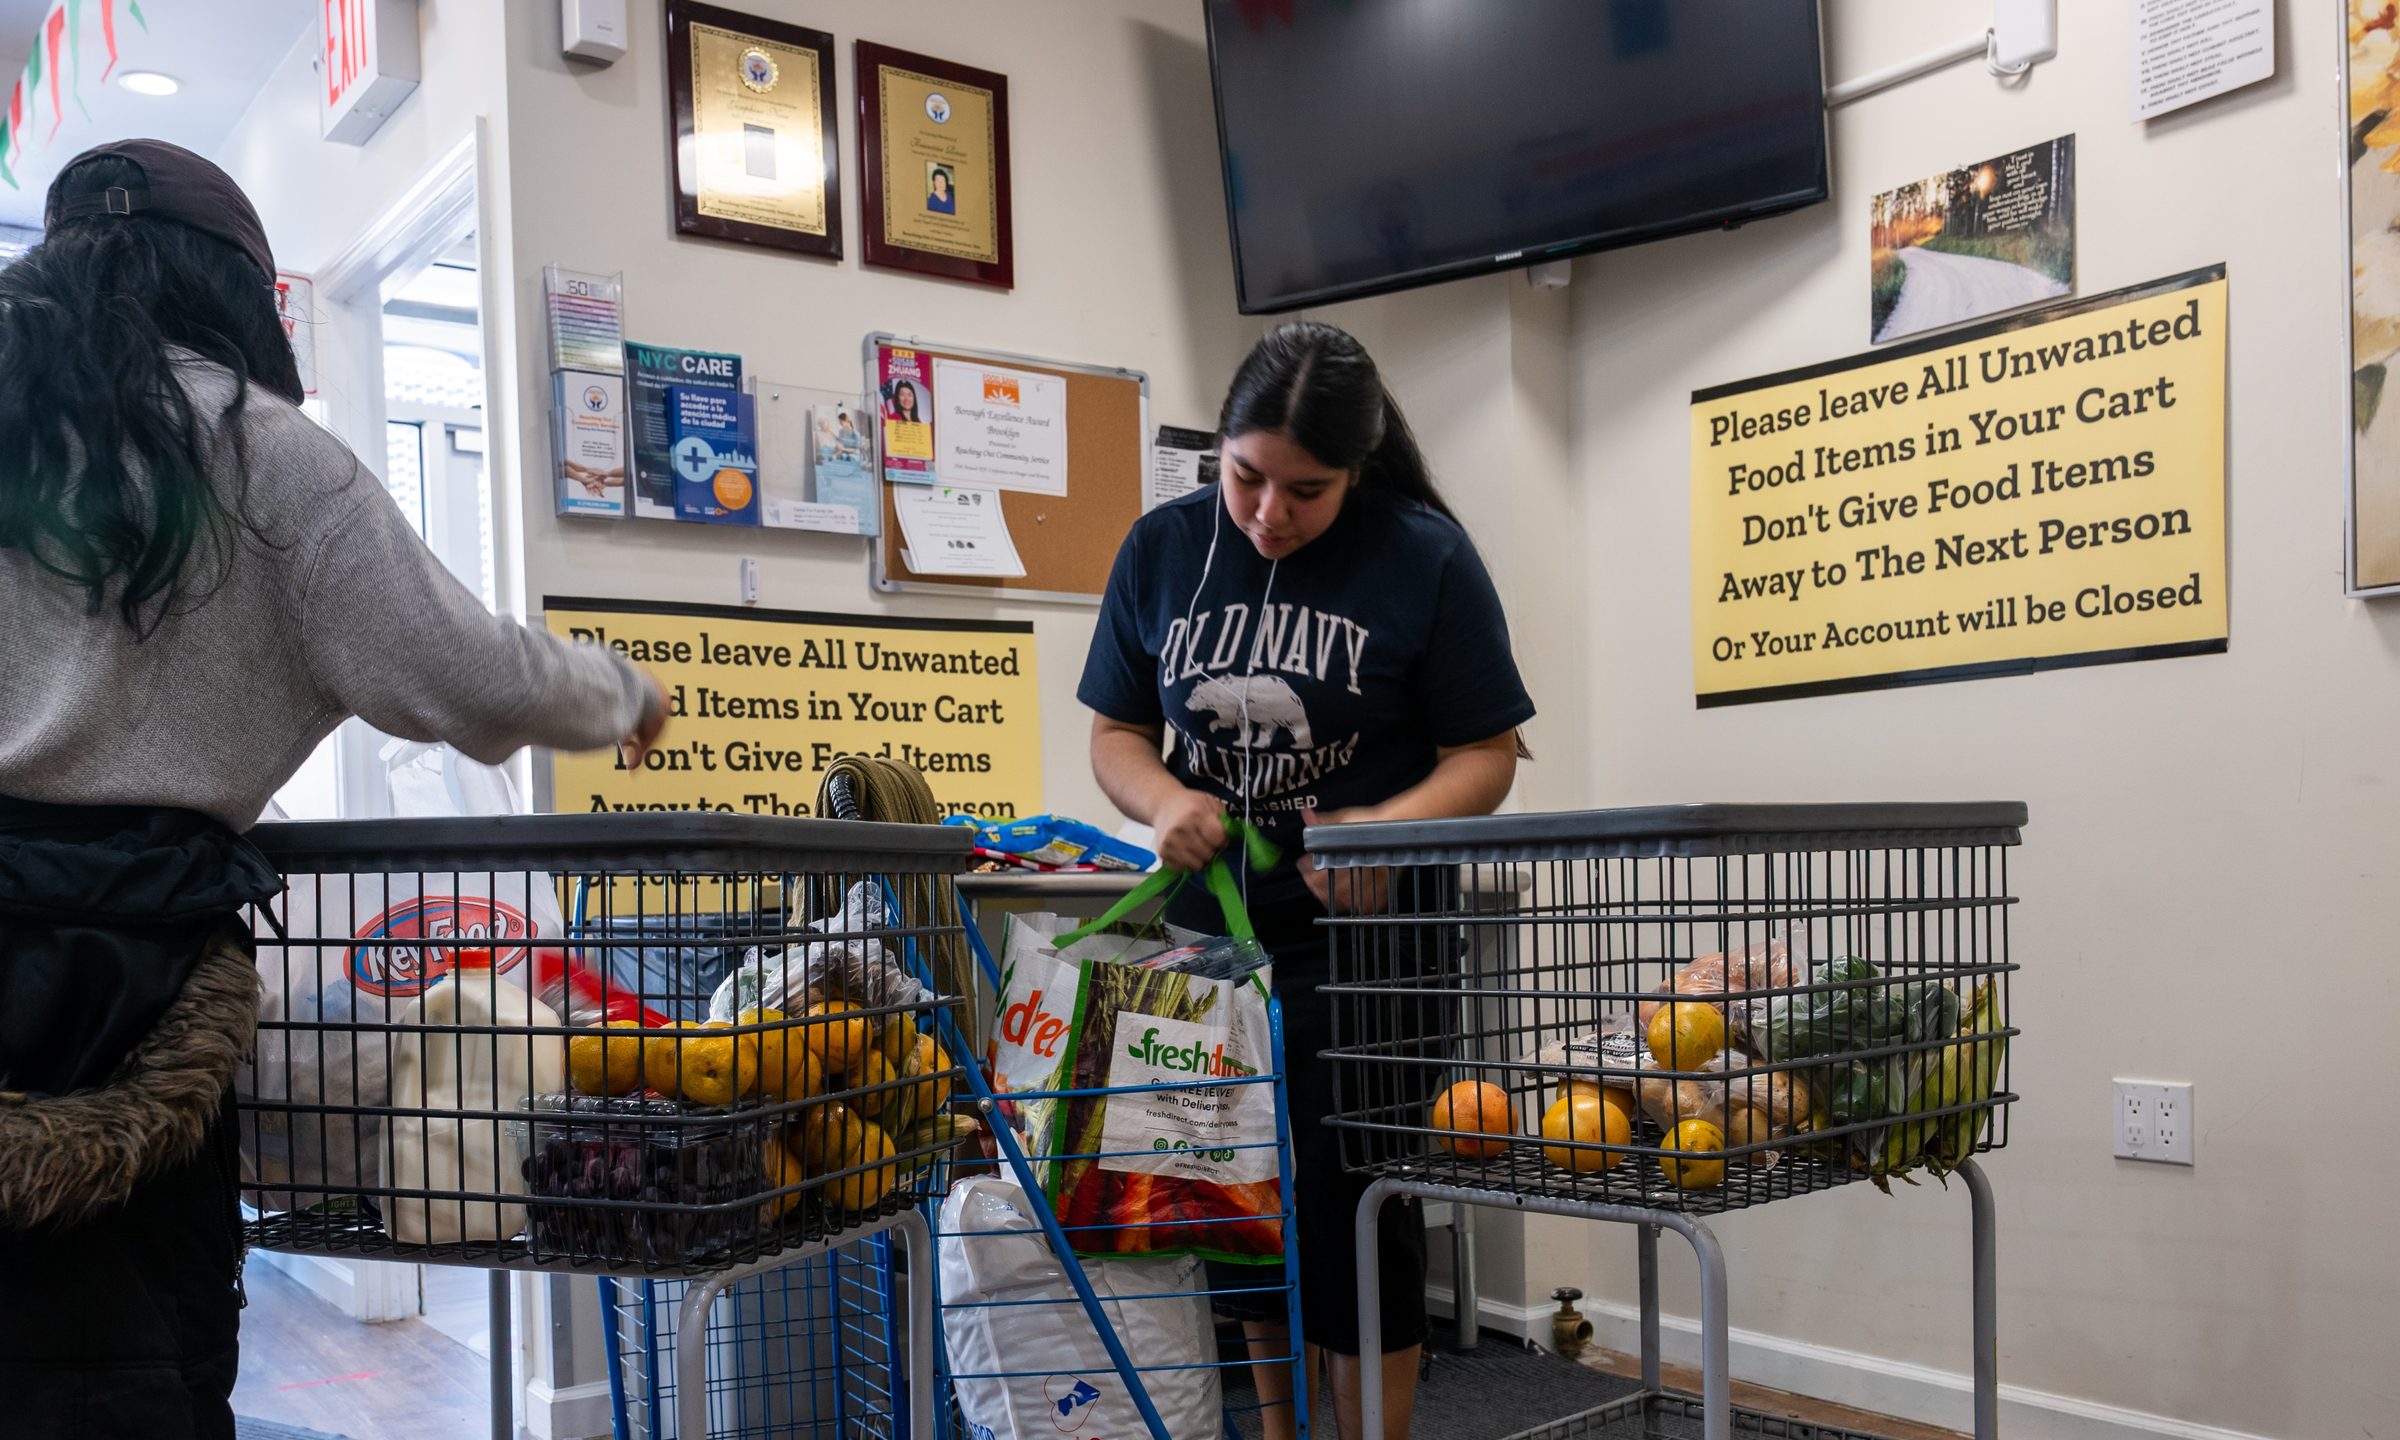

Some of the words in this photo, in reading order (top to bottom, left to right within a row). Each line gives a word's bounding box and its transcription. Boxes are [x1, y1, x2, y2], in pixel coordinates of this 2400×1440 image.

[638, 349, 678, 371] NYC
[681, 355, 733, 377] CARE
[888, 364, 921, 378] ZHUANG
[1709, 403, 1811, 446] Please
[1819, 381, 1909, 422] leave
[1916, 356, 1969, 400] All
[1979, 299, 2202, 384] Unwanted
[680, 392, 690, 401] Su
[691, 393, 709, 403] llave
[710, 397, 727, 405] para
[680, 402, 709, 411] acceder
[716, 404, 724, 412] la
[680, 409, 711, 419] atención
[711, 411, 737, 422] médica
[681, 417, 690, 425] de
[692, 418, 700, 426] la
[701, 419, 726, 429] ciudad
[954, 405, 985, 421] Borough
[986, 410, 1025, 424] Excellence
[1025, 416, 1051, 427] Award
[986, 425, 1020, 441] Brooklyn
[1728, 450, 1806, 495] Food
[1814, 436, 1916, 477] Items
[1925, 422, 1961, 456] in
[1969, 398, 2066, 446] Your
[2076, 374, 2177, 424] Cart
[955, 446, 981, 460] Reaching
[983, 450, 995, 458] Out
[996, 451, 1029, 464] Community
[1742, 504, 1831, 546] Don't
[1838, 493, 1919, 528] Give
[1928, 464, 2020, 513] Food
[2031, 449, 2155, 495] Items
[1718, 568, 1805, 602] Away
[1812, 559, 1847, 588] to
[1856, 544, 1925, 582] The
[1934, 528, 2029, 570] Next
[2038, 508, 2191, 555] Person
[1713, 636, 1746, 662] Or
[1751, 628, 1817, 657] Your
[1822, 609, 1950, 650] Account
[1957, 598, 2017, 633] will
[2025, 594, 2066, 624] be
[2074, 573, 2202, 618] Closed
[700, 632, 791, 668] leave
[799, 639, 847, 670] All
[855, 640, 1020, 677] Unwanted
[1161, 603, 1249, 687] OLD
[1251, 603, 1369, 695] NAVY
[697, 687, 799, 720] Items
[808, 690, 840, 722] in
[847, 693, 926, 723] Your
[934, 695, 1004, 725] Cart
[725, 741, 803, 772] Give
[367, 930, 423, 982] Key
[429, 912, 508, 962] Food
[1156, 1094, 1178, 1105] with
